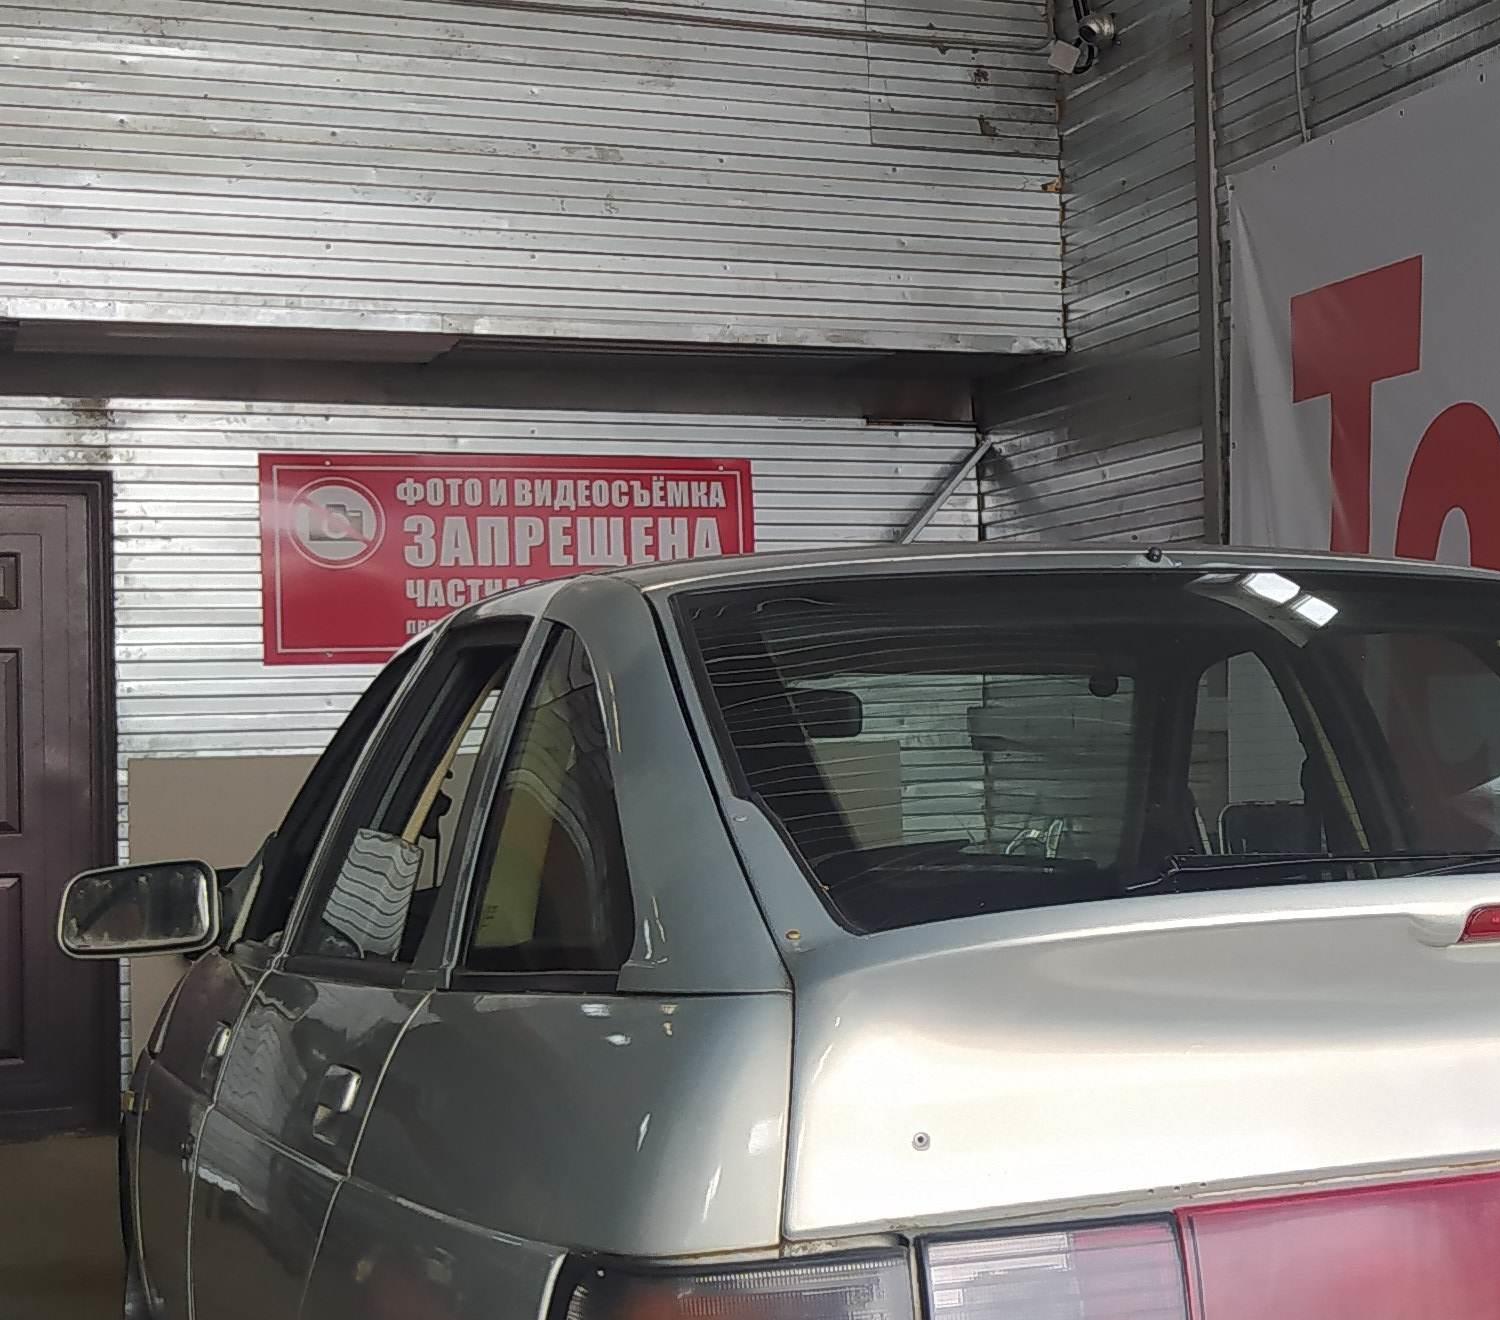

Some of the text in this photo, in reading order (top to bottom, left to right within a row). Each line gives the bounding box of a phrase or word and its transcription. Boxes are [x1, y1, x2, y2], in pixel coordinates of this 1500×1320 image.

[396, 475, 727, 511] ФОТО И ВИДЕОСЪЁМКА
[403, 515, 723, 567] ЗАПРЕЩЕНА
